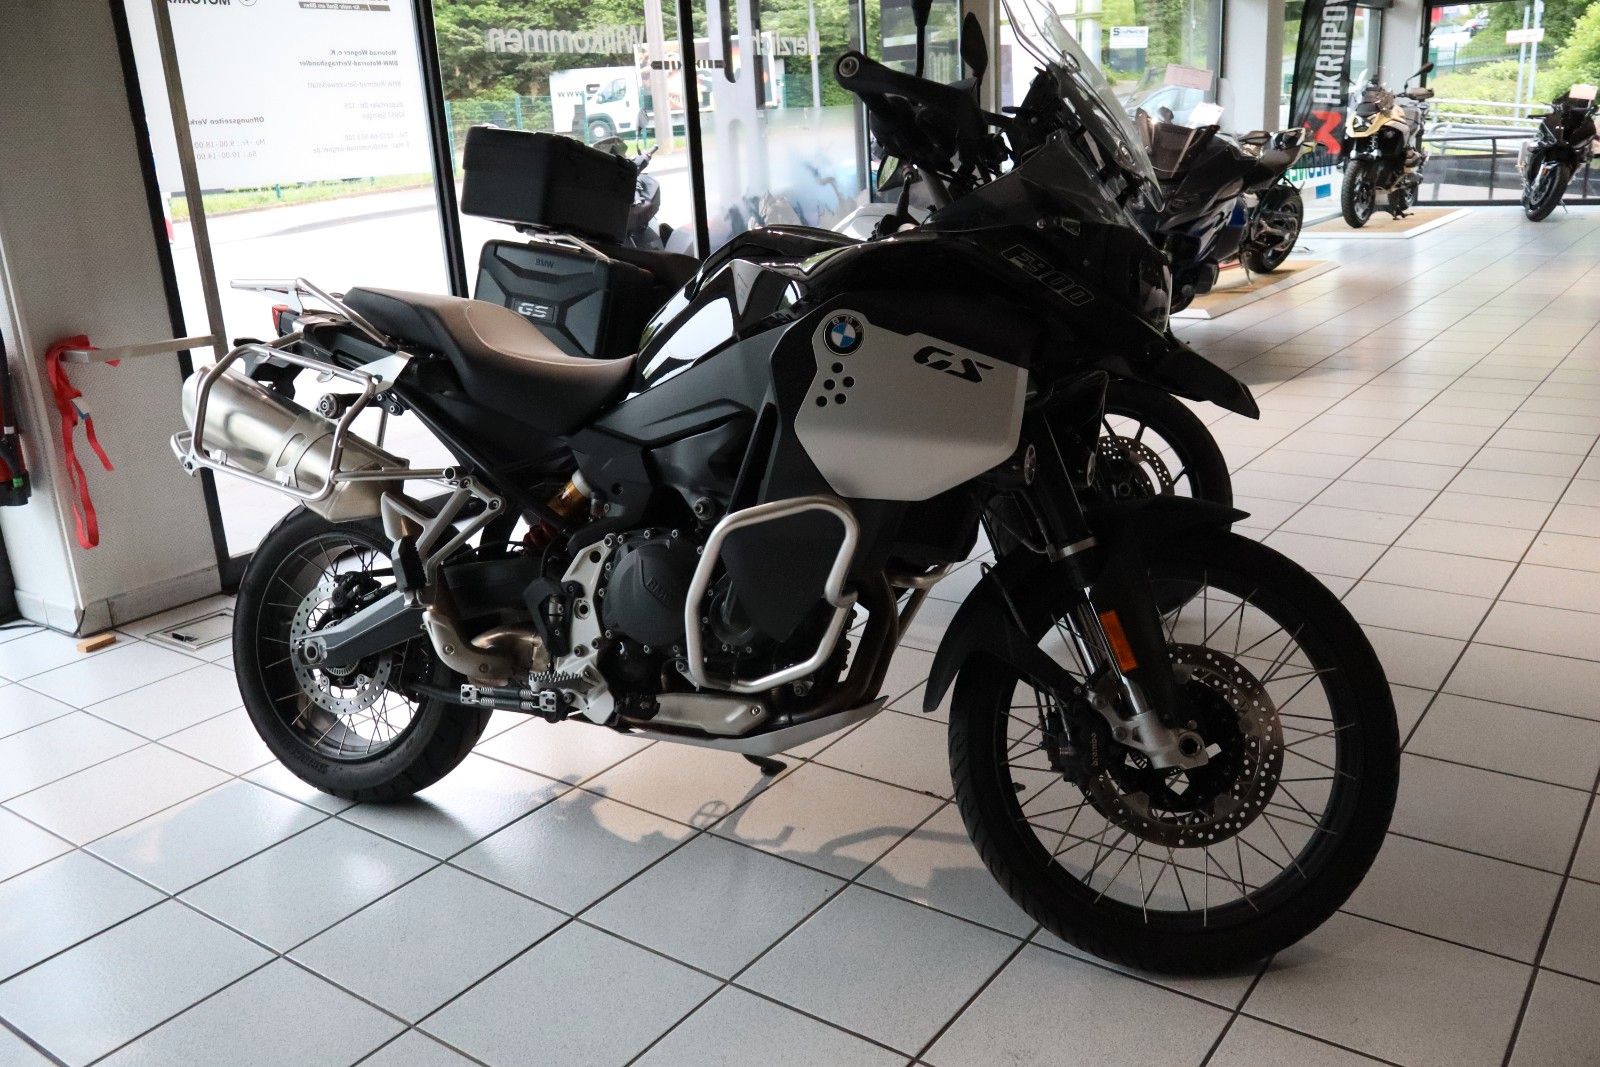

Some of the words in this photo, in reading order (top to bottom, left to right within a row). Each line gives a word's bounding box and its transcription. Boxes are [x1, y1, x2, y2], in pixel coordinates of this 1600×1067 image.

[1312, 0, 1350, 104] AKRAPO
[518, 302, 549, 319] GS
[913, 345, 995, 384] GS
